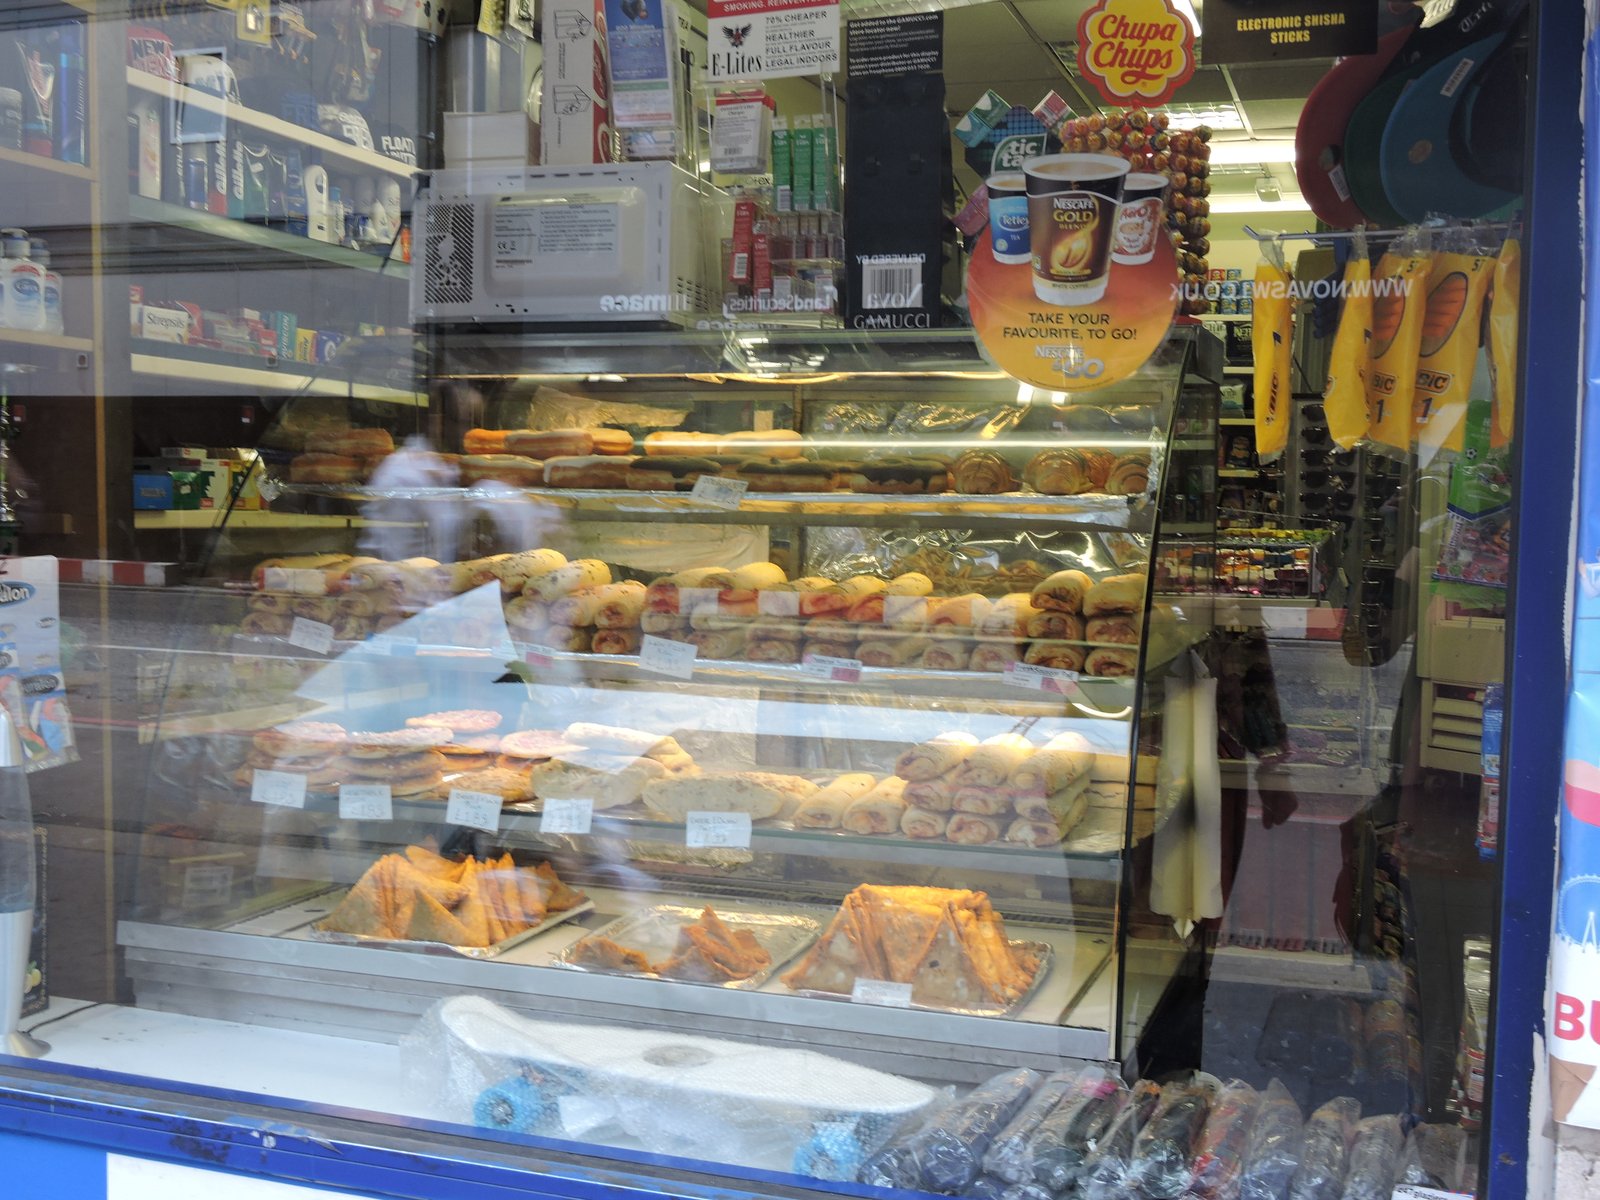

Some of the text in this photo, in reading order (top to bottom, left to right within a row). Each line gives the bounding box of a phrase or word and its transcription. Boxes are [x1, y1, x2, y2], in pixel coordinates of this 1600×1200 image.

[784, 10, 828, 23] CHEAPER
[1237, 12, 1346, 32] ELECTRONIC SHISHA
[765, 29, 816, 41] HEALTHIER
[1098, 14, 1178, 48] Chupa
[1270, 29, 1311, 44] STICKS
[765, 46, 788, 55] FULL
[789, 41, 831, 53] FLAVOUR
[712, 50, 762, 76] E-Lites
[765, 58, 795, 68] LEGAL
[796, 53, 838, 66] INDOORS
[1093, 41, 1174, 84] Chups
[1009, 138, 1038, 155] tic
[1002, 152, 1036, 168] ta
[232, 140, 244, 201] Gillette
[1053, 209, 1093, 222] GOLD
[146, 312, 186, 330] Strepsils
[853, 313, 931, 329] GAMUCCI
[1028, 312, 1110, 326] TAKE YOUR
[1002, 326, 1138, 340] FAVOURITE, TO GO!
[1417, 372, 1449, 390] BIC
